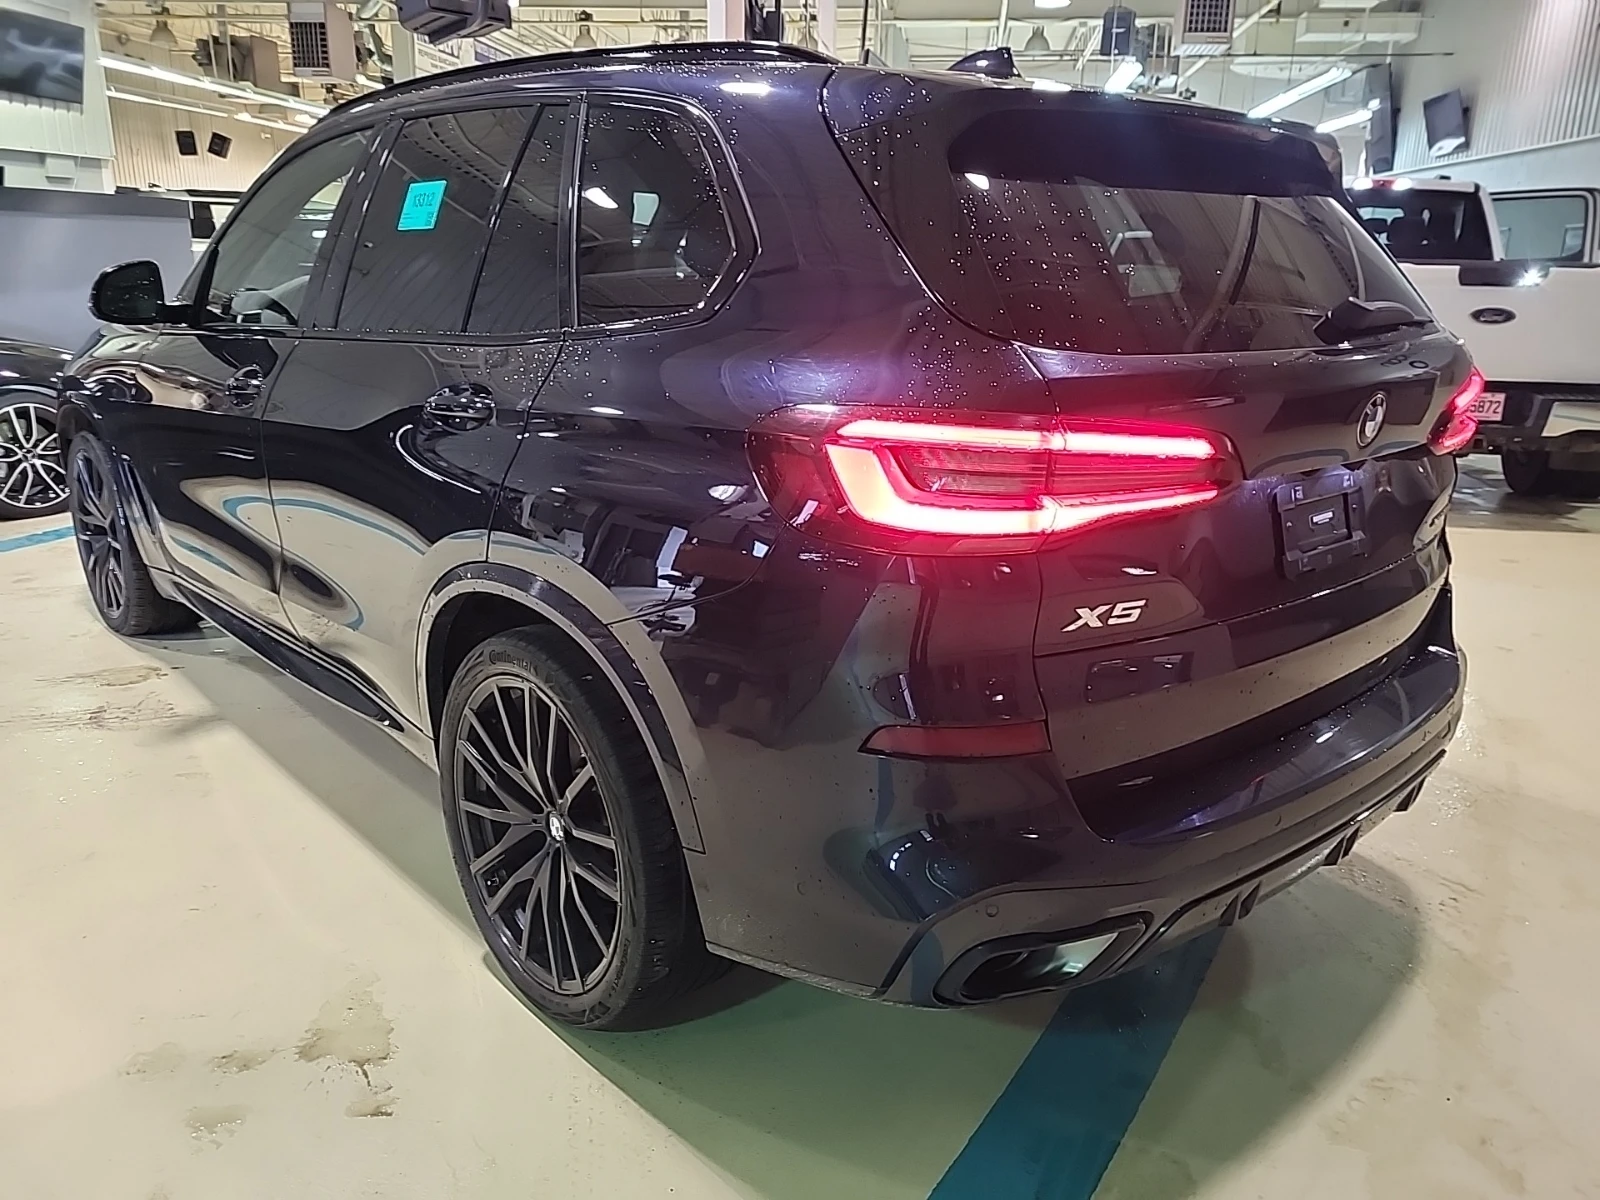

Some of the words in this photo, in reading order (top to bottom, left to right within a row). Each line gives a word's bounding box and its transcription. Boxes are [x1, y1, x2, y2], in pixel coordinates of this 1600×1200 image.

[1466, 399, 1502, 415] 5872
[1061, 600, 1147, 632] X5
[488, 649, 532, 673] Continental
